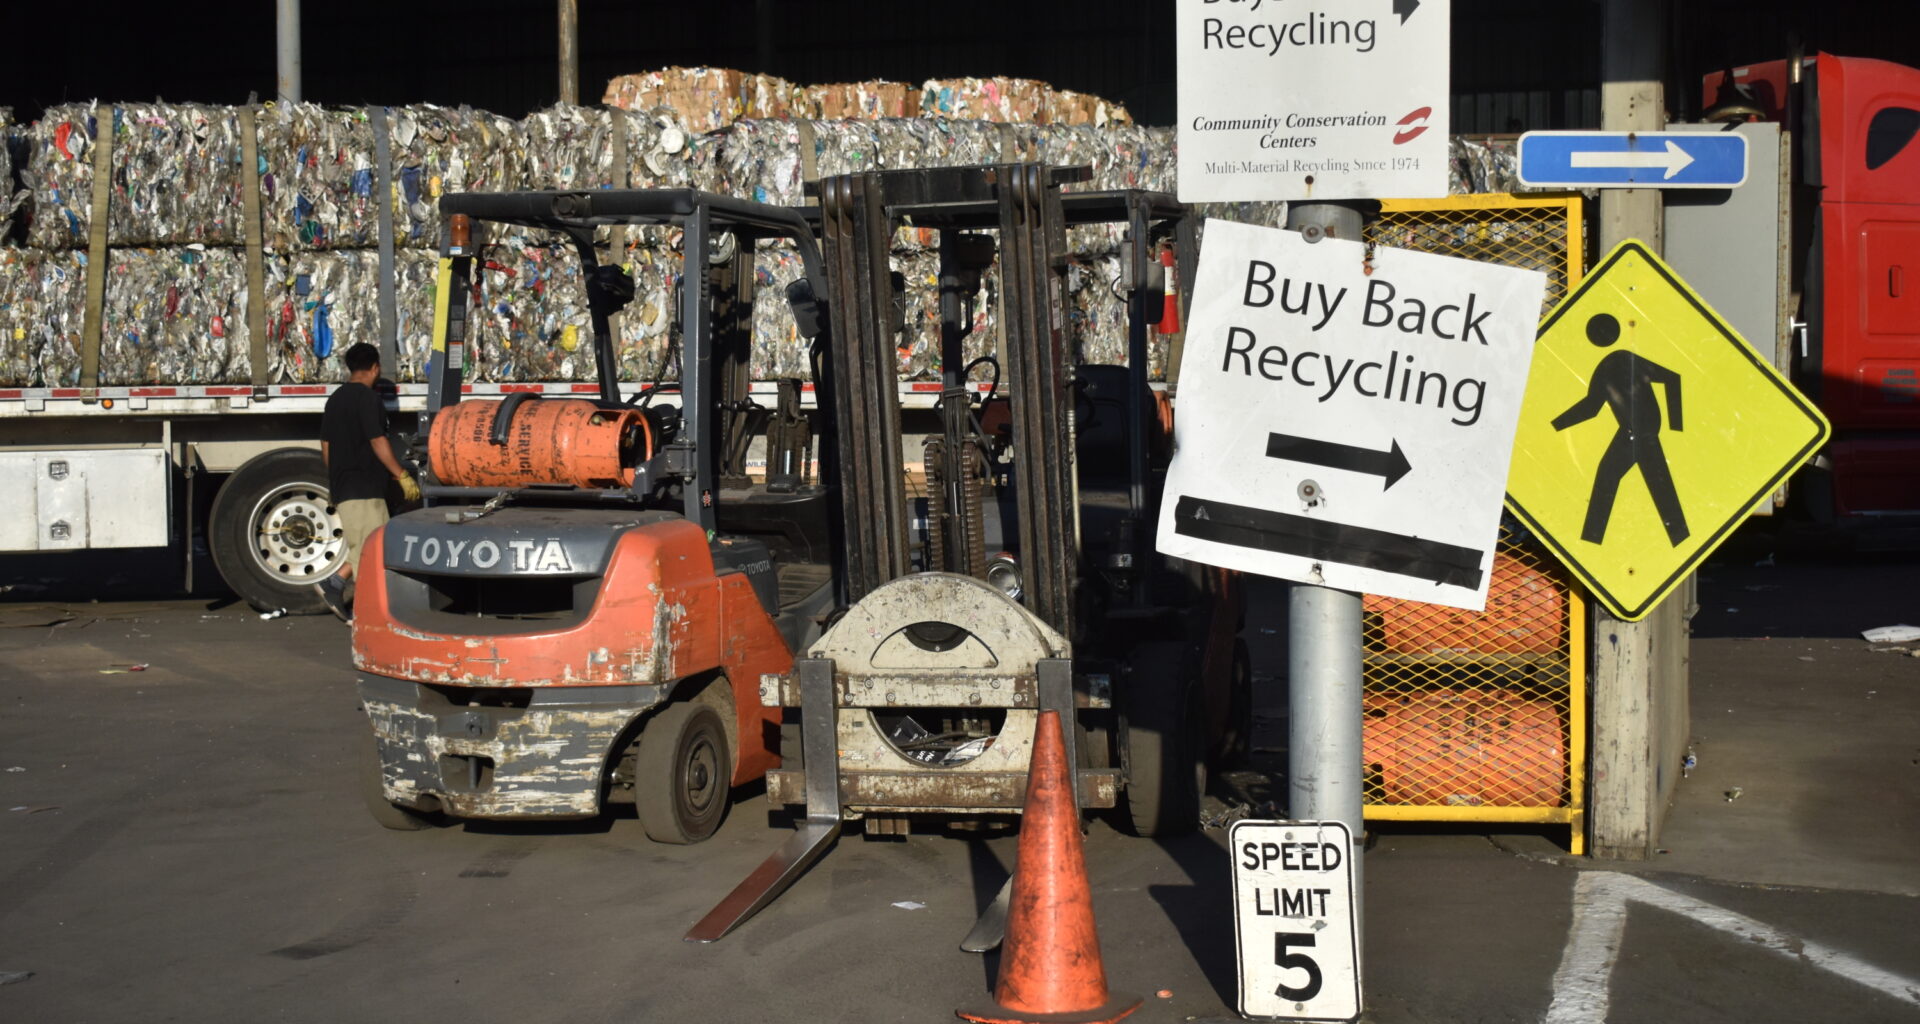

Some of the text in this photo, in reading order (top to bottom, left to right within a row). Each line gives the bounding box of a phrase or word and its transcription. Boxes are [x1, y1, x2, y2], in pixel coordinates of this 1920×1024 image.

[1203, 12, 1376, 56] Recycling
[1193, 111, 1387, 133] Community Conservation
[1260, 133, 1317, 149] Centers
[1205, 157, 1420, 175] Multi-Material Recycling Since 1974
[1243, 260, 1493, 346] Buy Back
[1222, 326, 1487, 426] Recycling
[517, 424, 533, 476] SERVICE
[403, 535, 572, 571] TOYOTA
[747, 560, 771, 575] TOYOTA
[1242, 842, 1342, 871] SPEED
[1255, 888, 1331, 917] LIMIT
[1274, 932, 1323, 1002] 5
